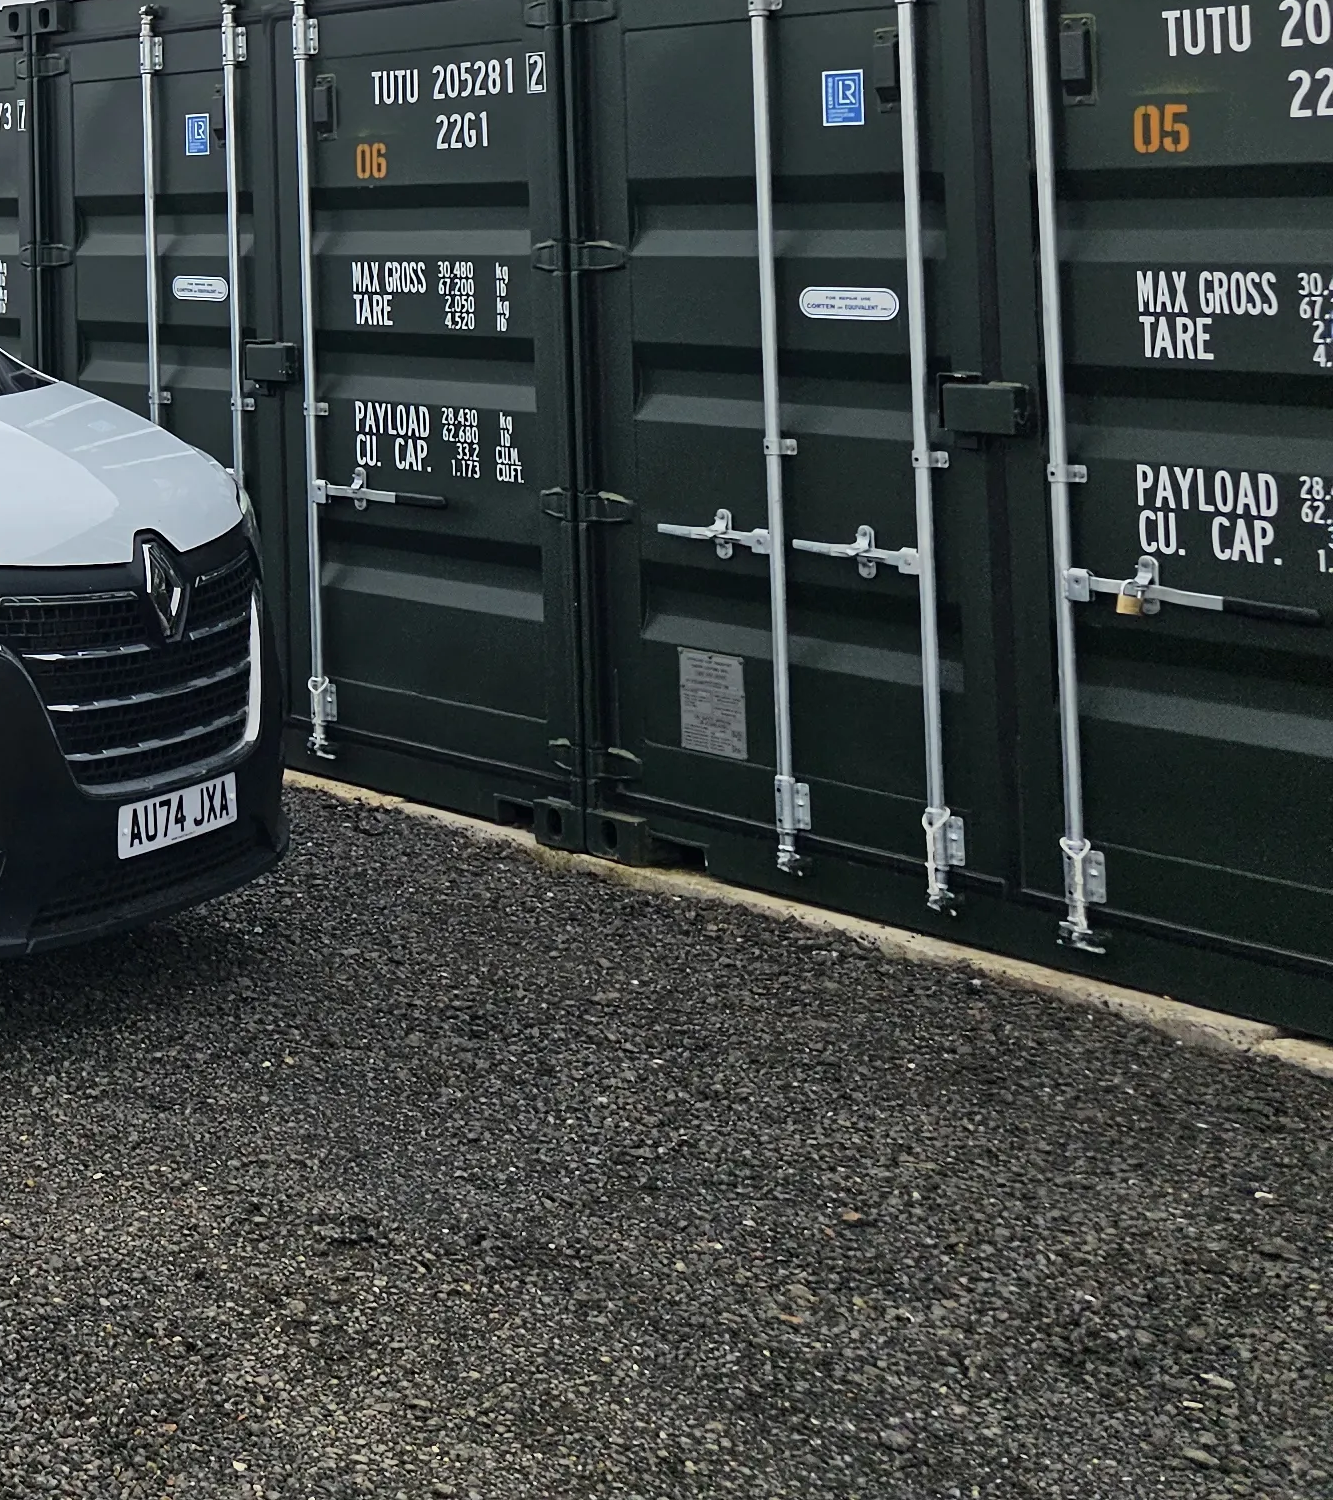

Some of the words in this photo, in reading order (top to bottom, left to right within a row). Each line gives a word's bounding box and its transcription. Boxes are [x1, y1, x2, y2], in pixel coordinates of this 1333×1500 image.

[1161, 4, 1252, 57] TUTU
[371, 69, 419, 105] TUTU
[432, 57, 514, 100] 205281
[528, 54, 544, 92] 2
[838, 80, 856, 104] LR
[1287, 67, 1333, 118] 22
[17, 100, 26, 130] 7
[194, 121, 206, 139] LR
[435, 111, 488, 150] 22G1
[1134, 104, 1189, 153] 05
[356, 142, 387, 179] 06
[351, 261, 380, 293] MAX
[384, 261, 427, 294] GROSS
[437, 261, 474, 279] 30.480
[495, 262, 509, 284] kg
[438, 278, 475, 296] 67.200
[496, 280, 507, 297] lb
[1136, 270, 1189, 313] MAX
[1198, 270, 1279, 316] GROSS
[353, 294, 394, 326] TARE
[444, 295, 475, 313] 2.050
[496, 297, 510, 320] kg
[444, 312, 475, 330] 4.520
[496, 314, 508, 332] lb
[1299, 296, 1333, 320] 67.
[1138, 315, 1215, 360] TARE
[1312, 320, 1333, 344] 2.
[354, 401, 430, 438] PAYLOAD
[441, 407, 478, 426] 28.430
[499, 411, 513, 435] kg
[442, 424, 479, 444] 62.680
[500, 429, 511, 447] lb
[356, 433, 382, 467] CU.
[394, 437, 432, 473] CAP.
[456, 443, 480, 461] 33.2
[451, 459, 480, 479] 1.173
[1136, 464, 1279, 517] PAYLOAD
[1299, 475, 1333, 500] 28.
[1139, 510, 1186, 556] CU.
[1211, 516, 1283, 566] CAP.
[130, 794, 186, 848] AU74
[194, 780, 229, 827] JXA
